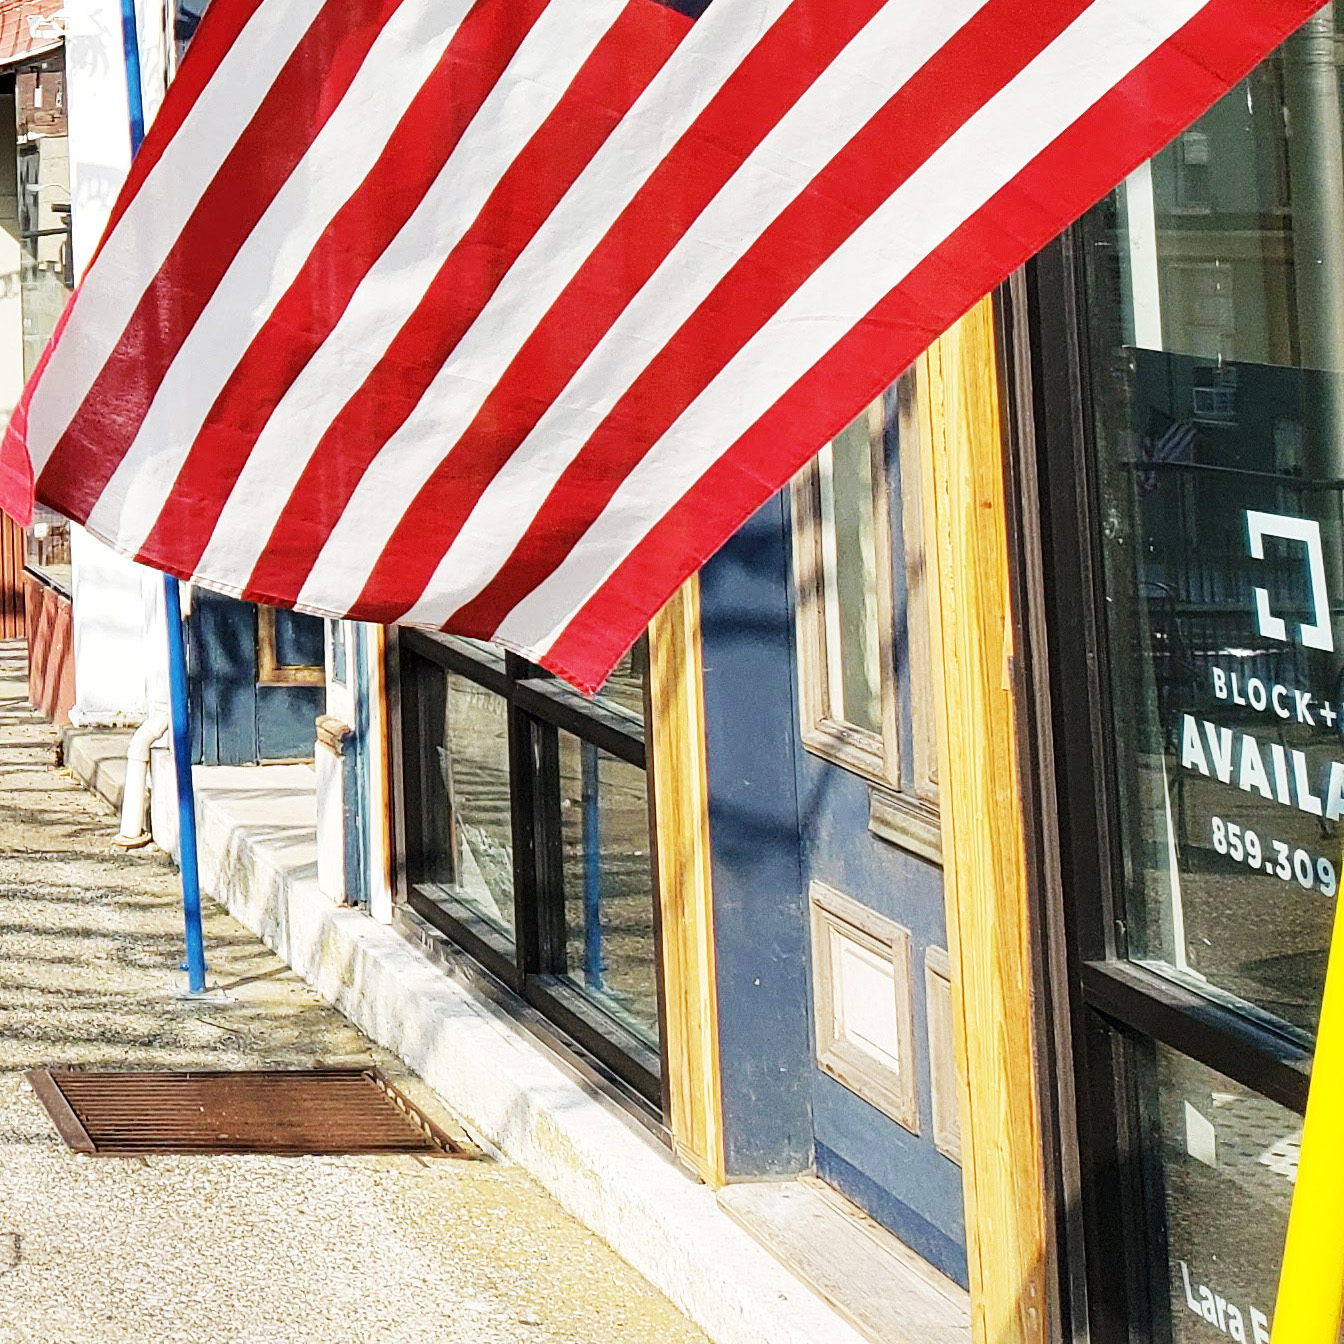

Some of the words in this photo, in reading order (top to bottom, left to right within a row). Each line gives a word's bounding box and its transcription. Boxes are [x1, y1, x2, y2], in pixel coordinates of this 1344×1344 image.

[1212, 666, 1344, 728] BLOCK+
[1211, 816, 1337, 898] 859.309
[1177, 1260, 1248, 1344] Lara
